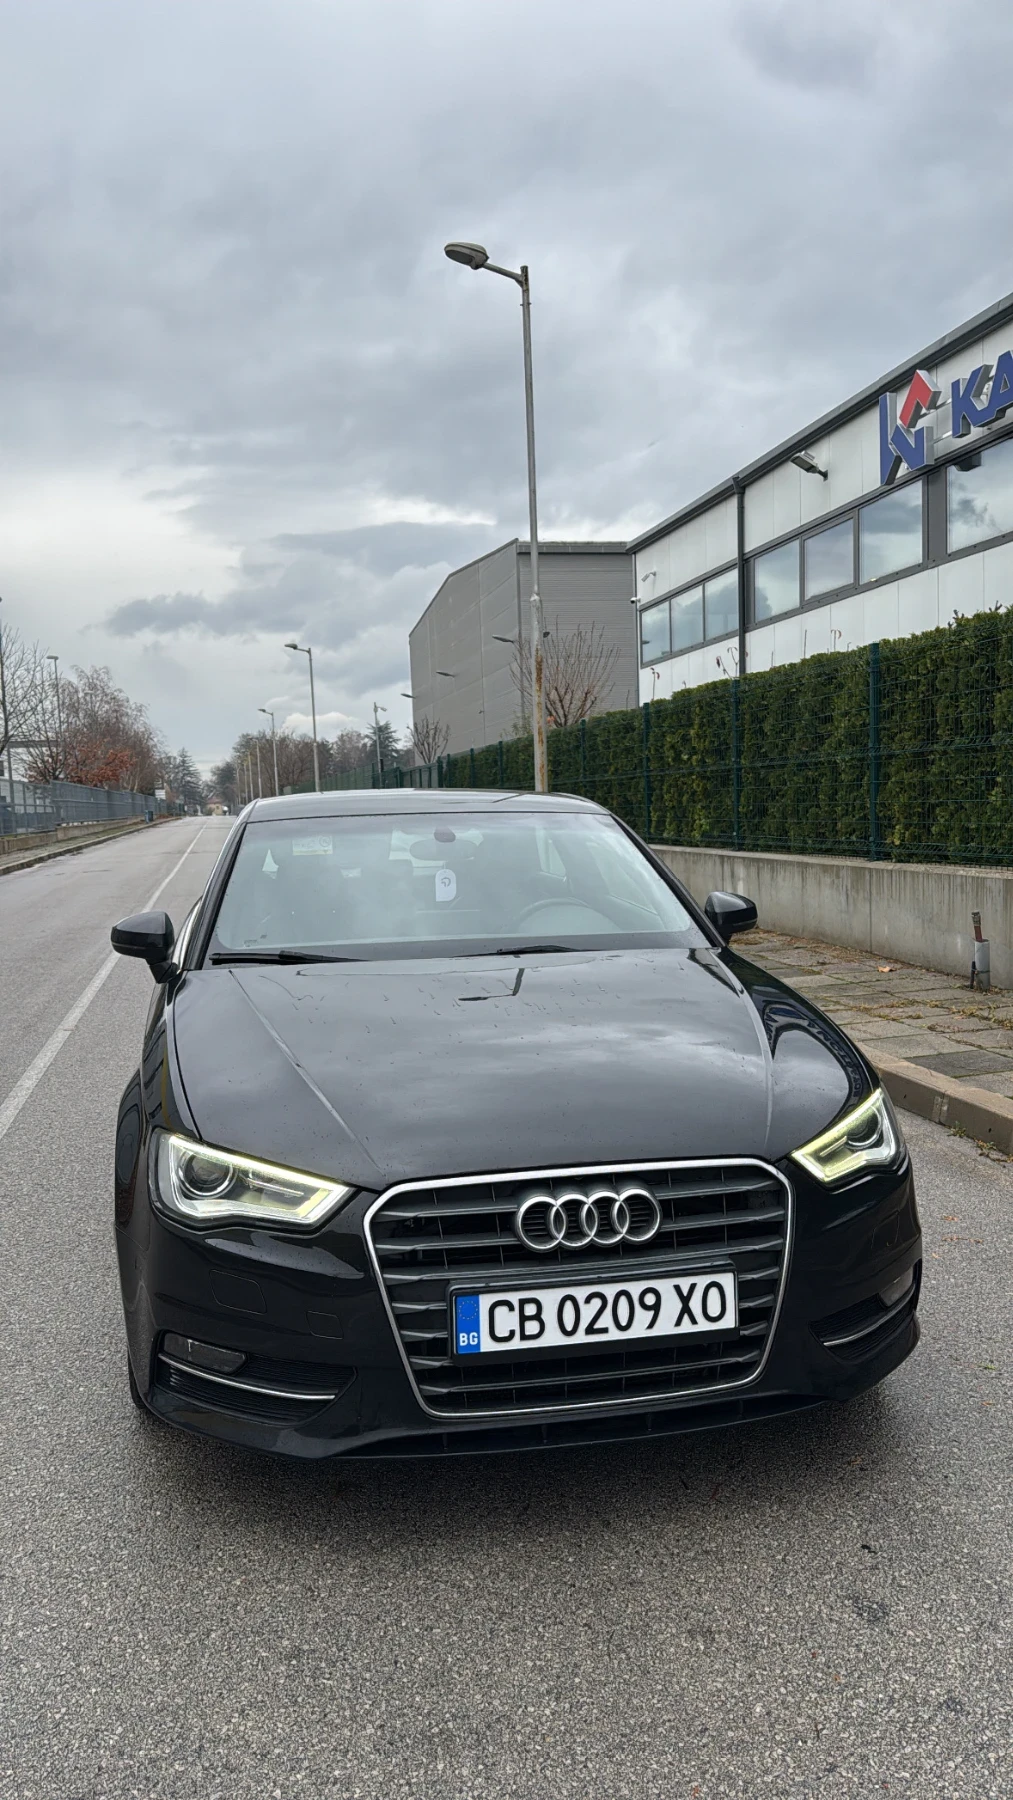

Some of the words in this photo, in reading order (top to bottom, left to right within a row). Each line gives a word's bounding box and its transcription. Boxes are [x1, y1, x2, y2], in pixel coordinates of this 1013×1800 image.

[488, 1297, 546, 1343] CB
[557, 1286, 662, 1337] 0209
[672, 1280, 727, 1328] XO
[459, 1332, 478, 1346] BG
